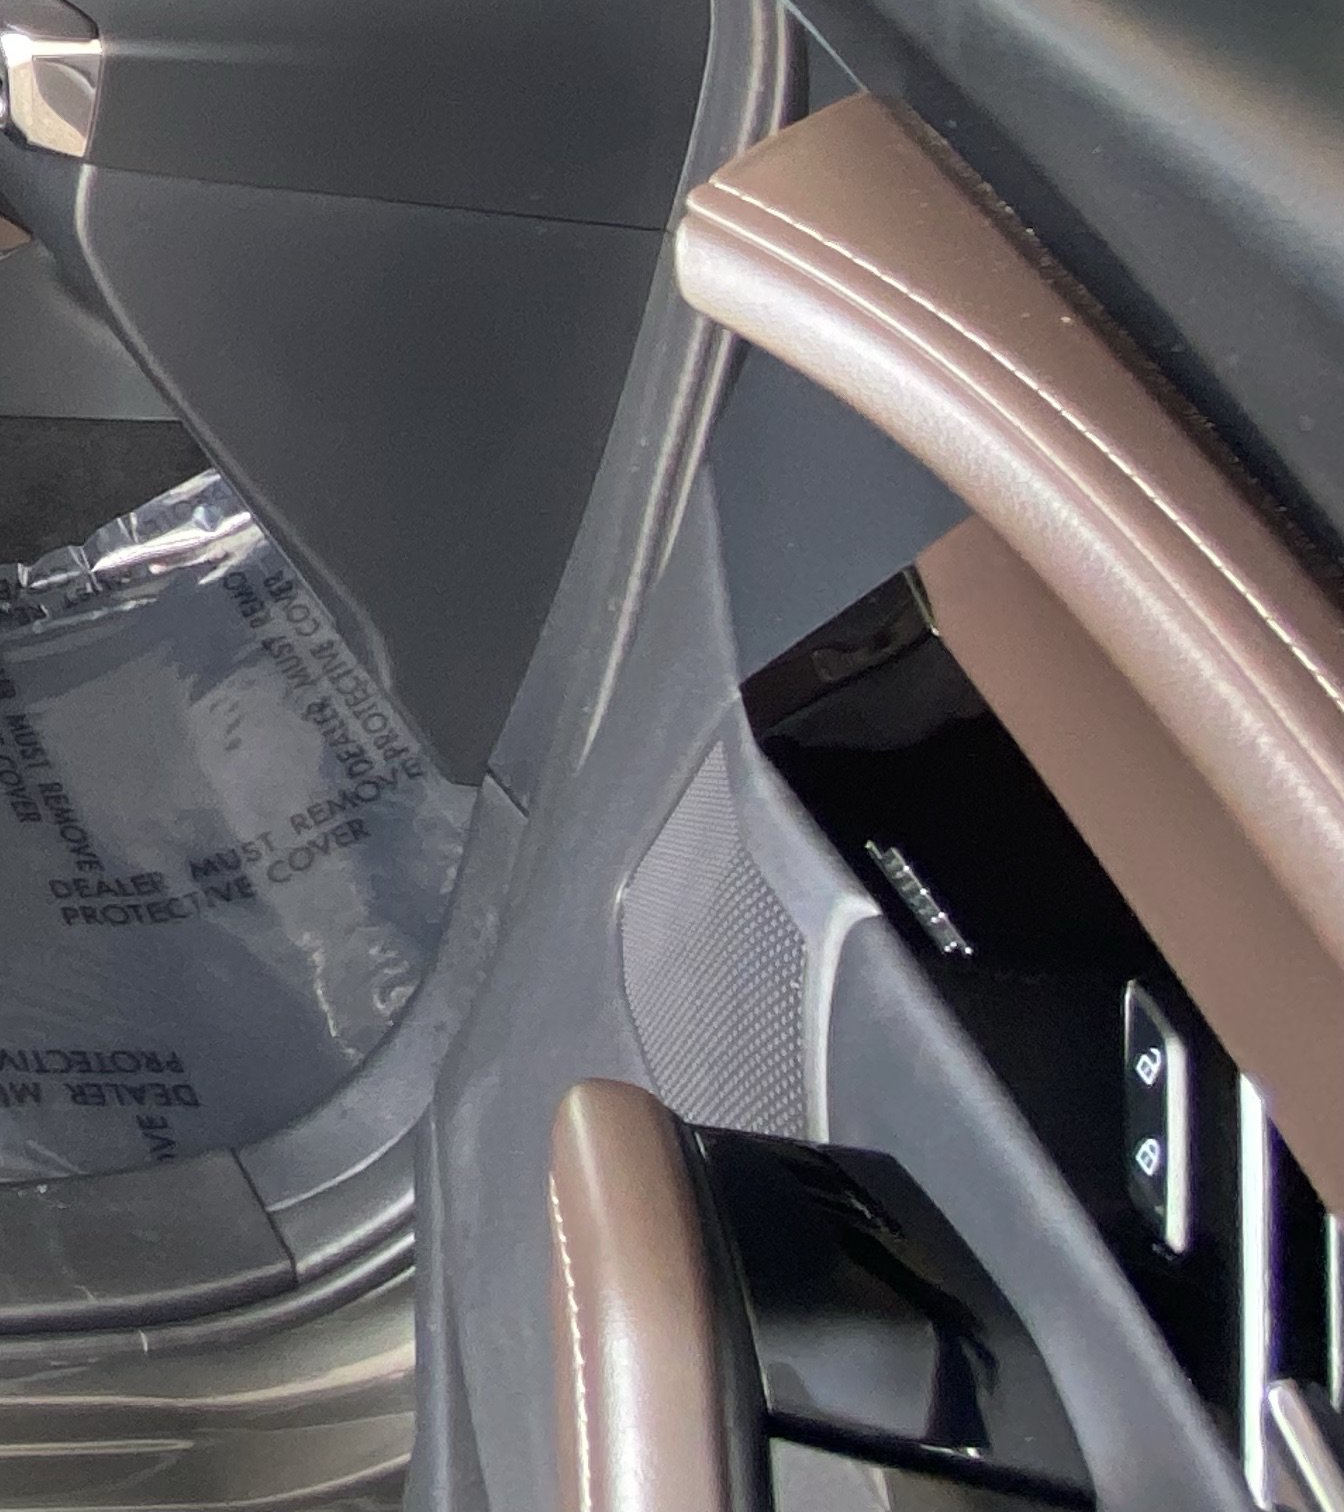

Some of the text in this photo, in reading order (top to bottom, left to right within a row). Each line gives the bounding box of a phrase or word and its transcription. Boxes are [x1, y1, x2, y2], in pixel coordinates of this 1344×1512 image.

[262, 637, 315, 691] MUST
[263, 570, 411, 760] PROTECTIVE COVER
[5, 712, 52, 770] MUST
[38, 781, 105, 873] REMOVE
[50, 760, 424, 902] DEALER MUST REMOVE
[61, 817, 372, 929] PROTECTIVE COVER
[71, 1081, 201, 1108] DEALER
